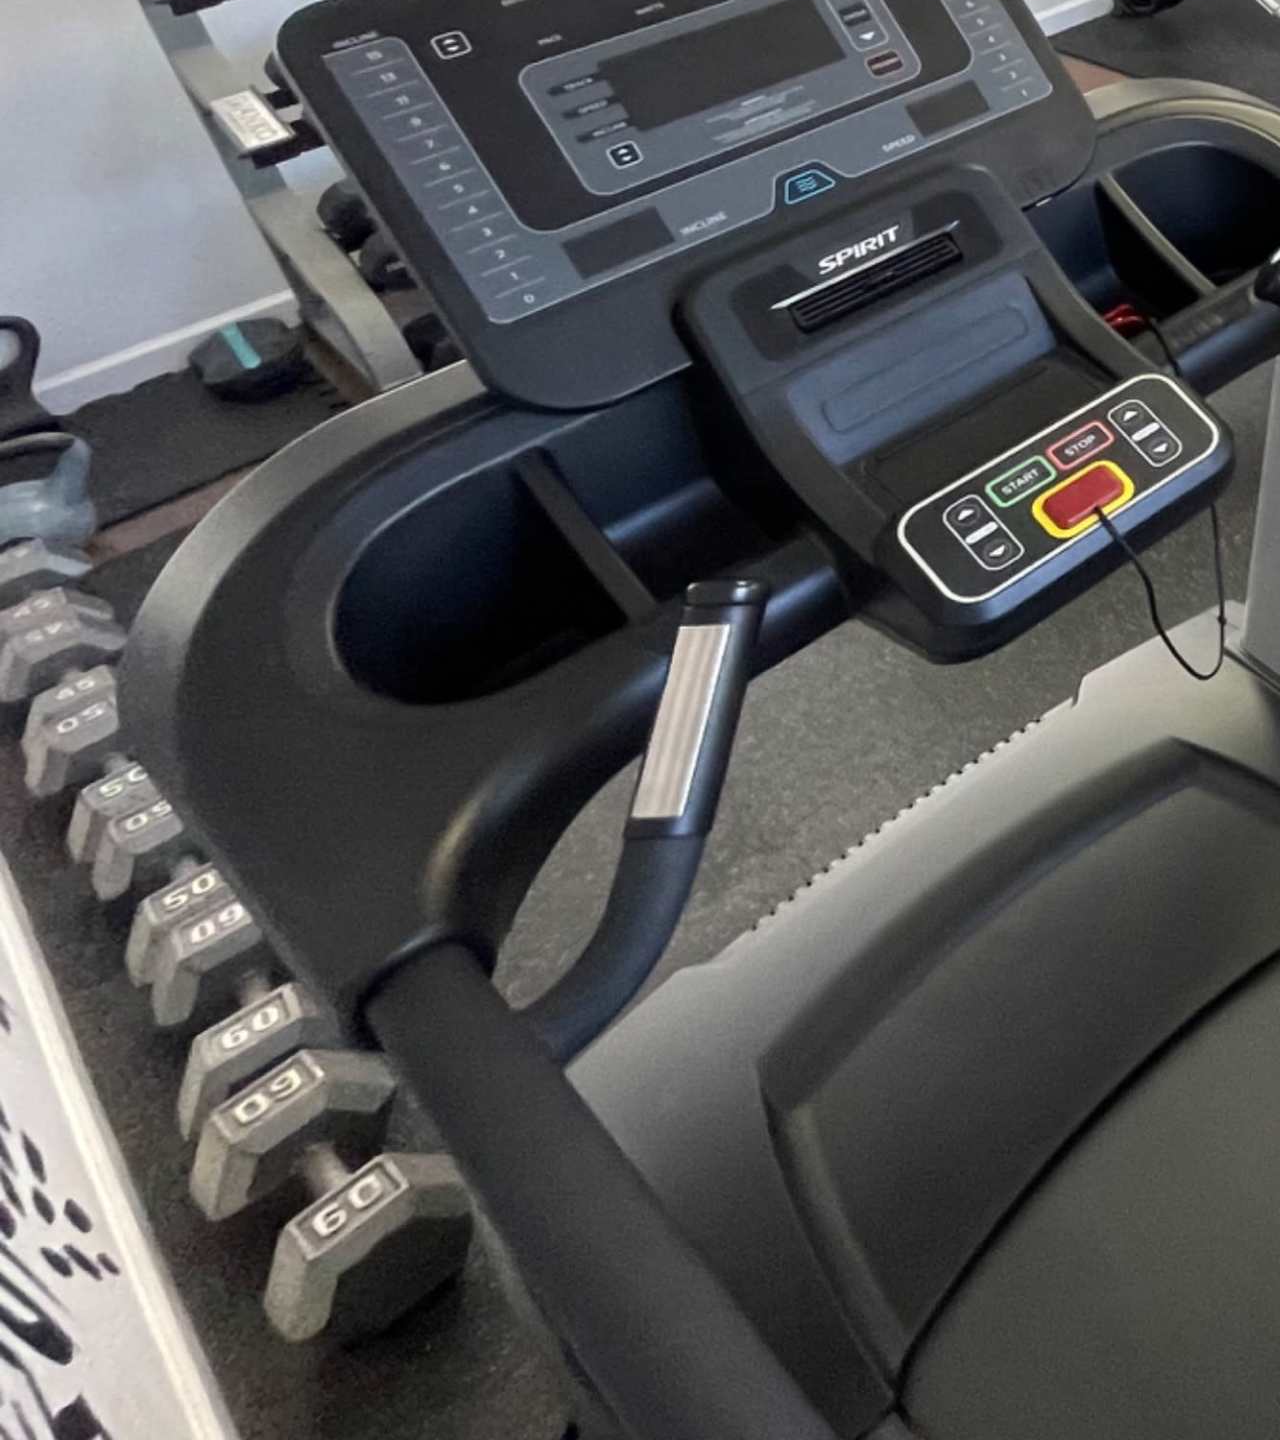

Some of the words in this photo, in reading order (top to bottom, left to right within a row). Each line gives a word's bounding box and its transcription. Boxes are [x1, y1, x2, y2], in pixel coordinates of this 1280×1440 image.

[881, 134, 916, 153] SPEED
[679, 210, 728, 236] INCLINE
[818, 224, 899, 275] SPIRIT
[1063, 433, 1097, 457] STOP
[1001, 467, 1040, 495] START
[162, 872, 216, 910] 50
[220, 1005, 280, 1049] 60
[311, 1173, 384, 1237] 60
